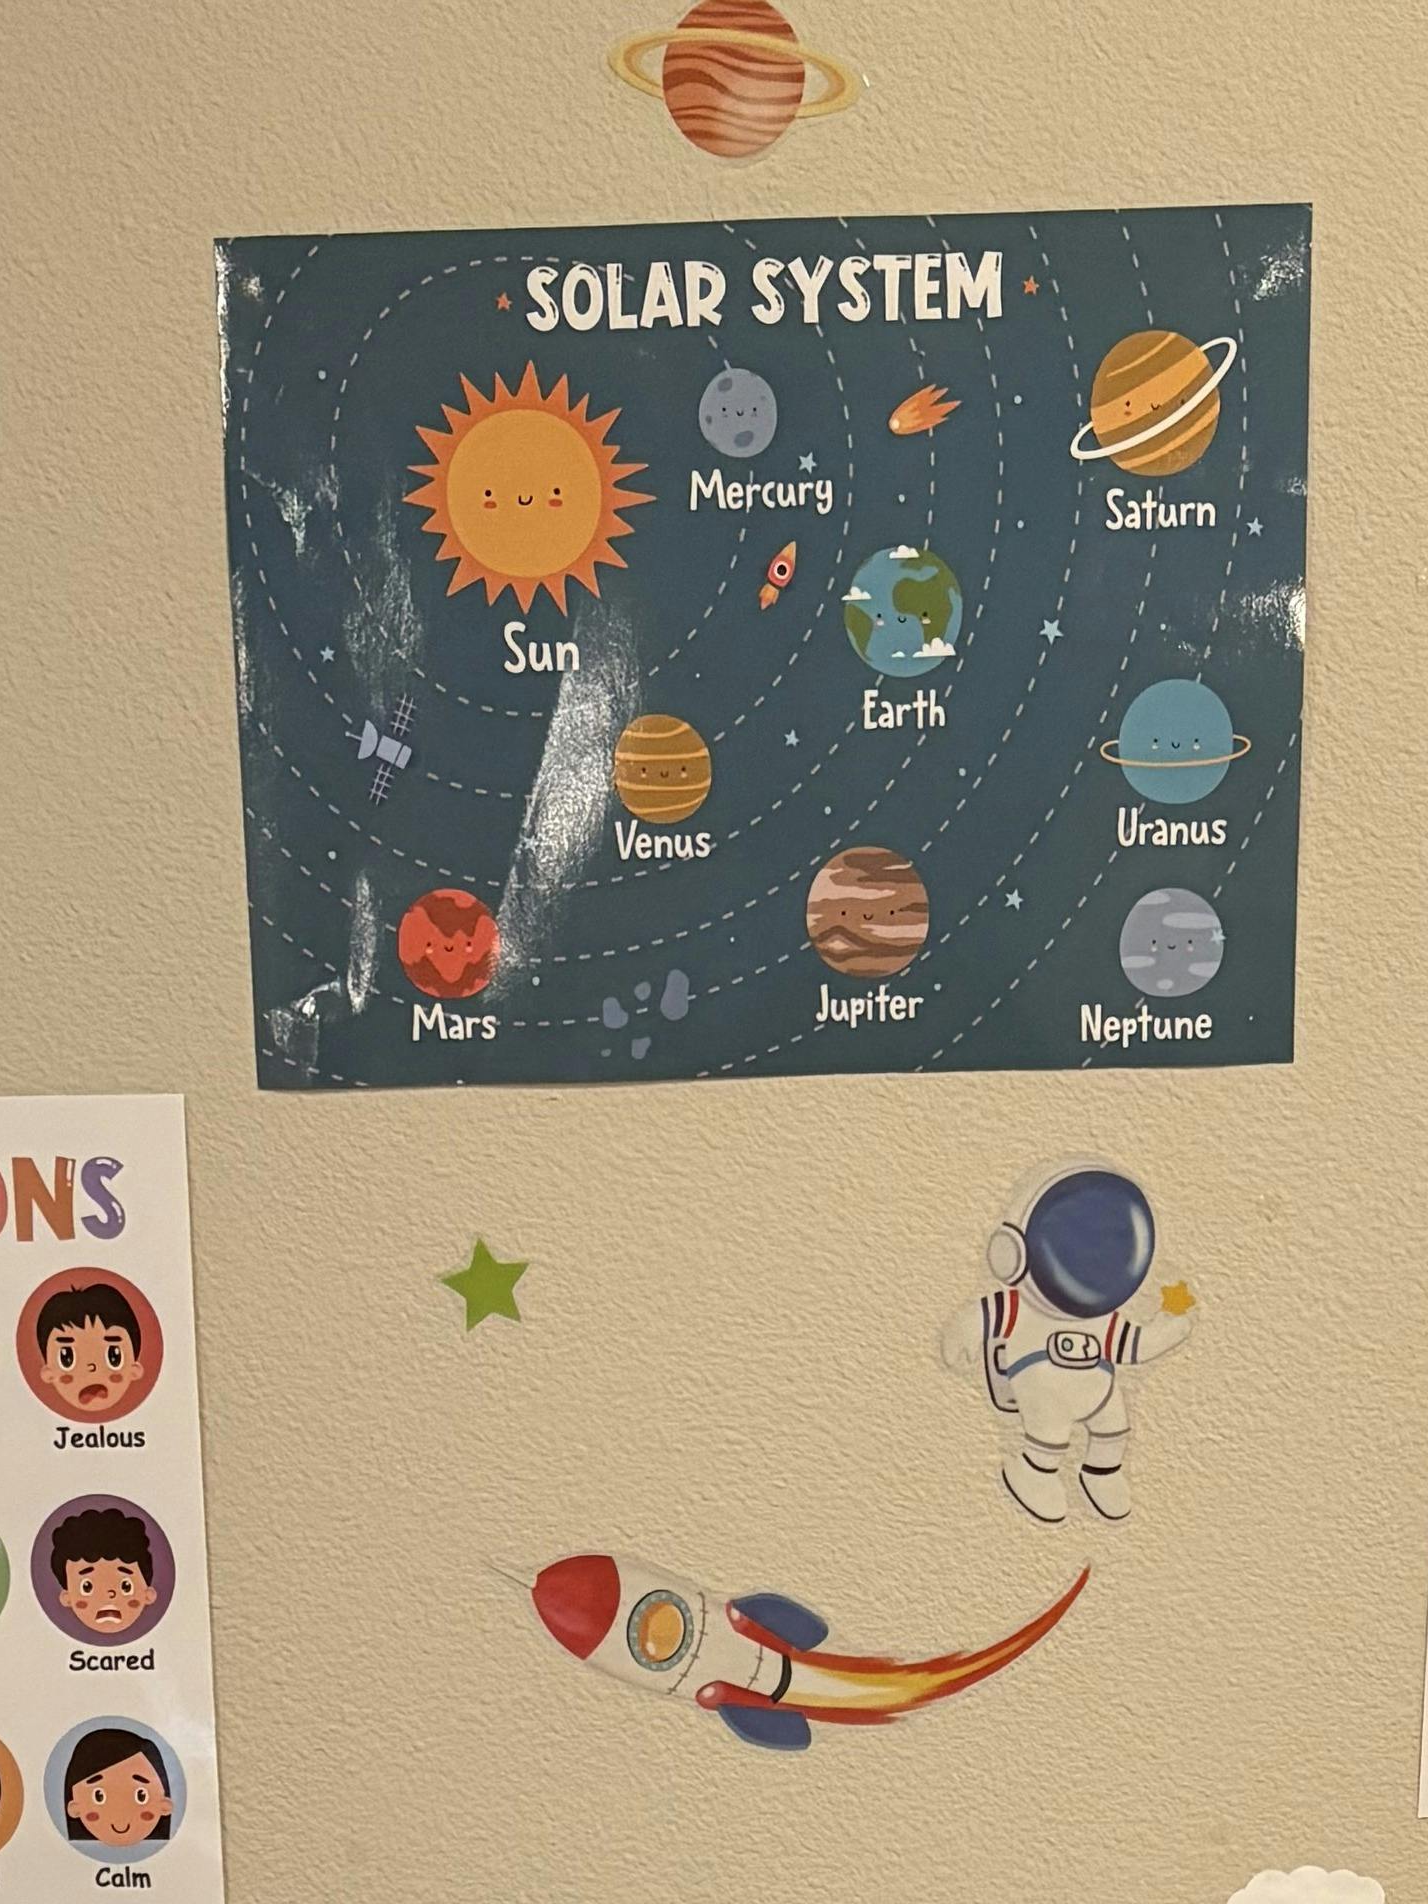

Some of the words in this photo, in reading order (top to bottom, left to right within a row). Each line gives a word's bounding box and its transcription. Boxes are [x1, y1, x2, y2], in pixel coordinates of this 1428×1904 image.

[526, 262, 728, 332] SOLAR
[751, 252, 1003, 324] SYSTEM
[689, 470, 833, 514] Mercury
[1106, 489, 1216, 530] Saturn
[503, 622, 580, 674] Sun
[863, 691, 946, 730] Earth
[614, 822, 711, 860] Venus
[1118, 810, 1227, 847] Uranus
[411, 1004, 496, 1043] Mars
[815, 989, 924, 1026] Jupiter
[1080, 1006, 1213, 1044] Neptune
[54, 1425, 146, 1450] Jealous
[69, 1650, 155, 1673] Scared
[95, 1868, 151, 1889] Calm
